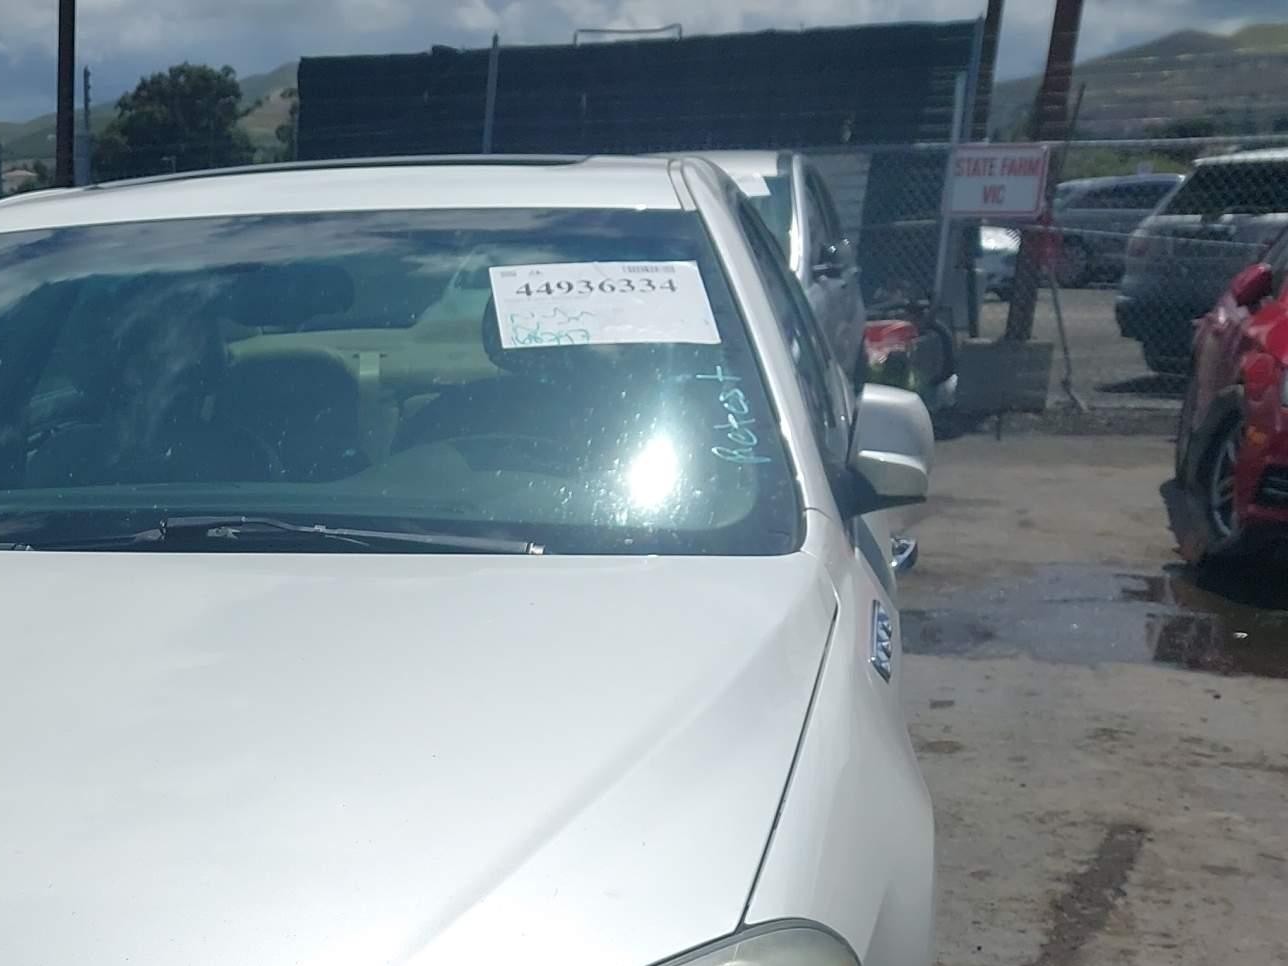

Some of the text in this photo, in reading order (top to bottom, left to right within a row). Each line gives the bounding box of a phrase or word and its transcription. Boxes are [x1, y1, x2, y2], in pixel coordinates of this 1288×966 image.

[953, 157, 1043, 176] STATE FARM
[983, 184, 1007, 204] VIC
[515, 278, 678, 297] 44936334
